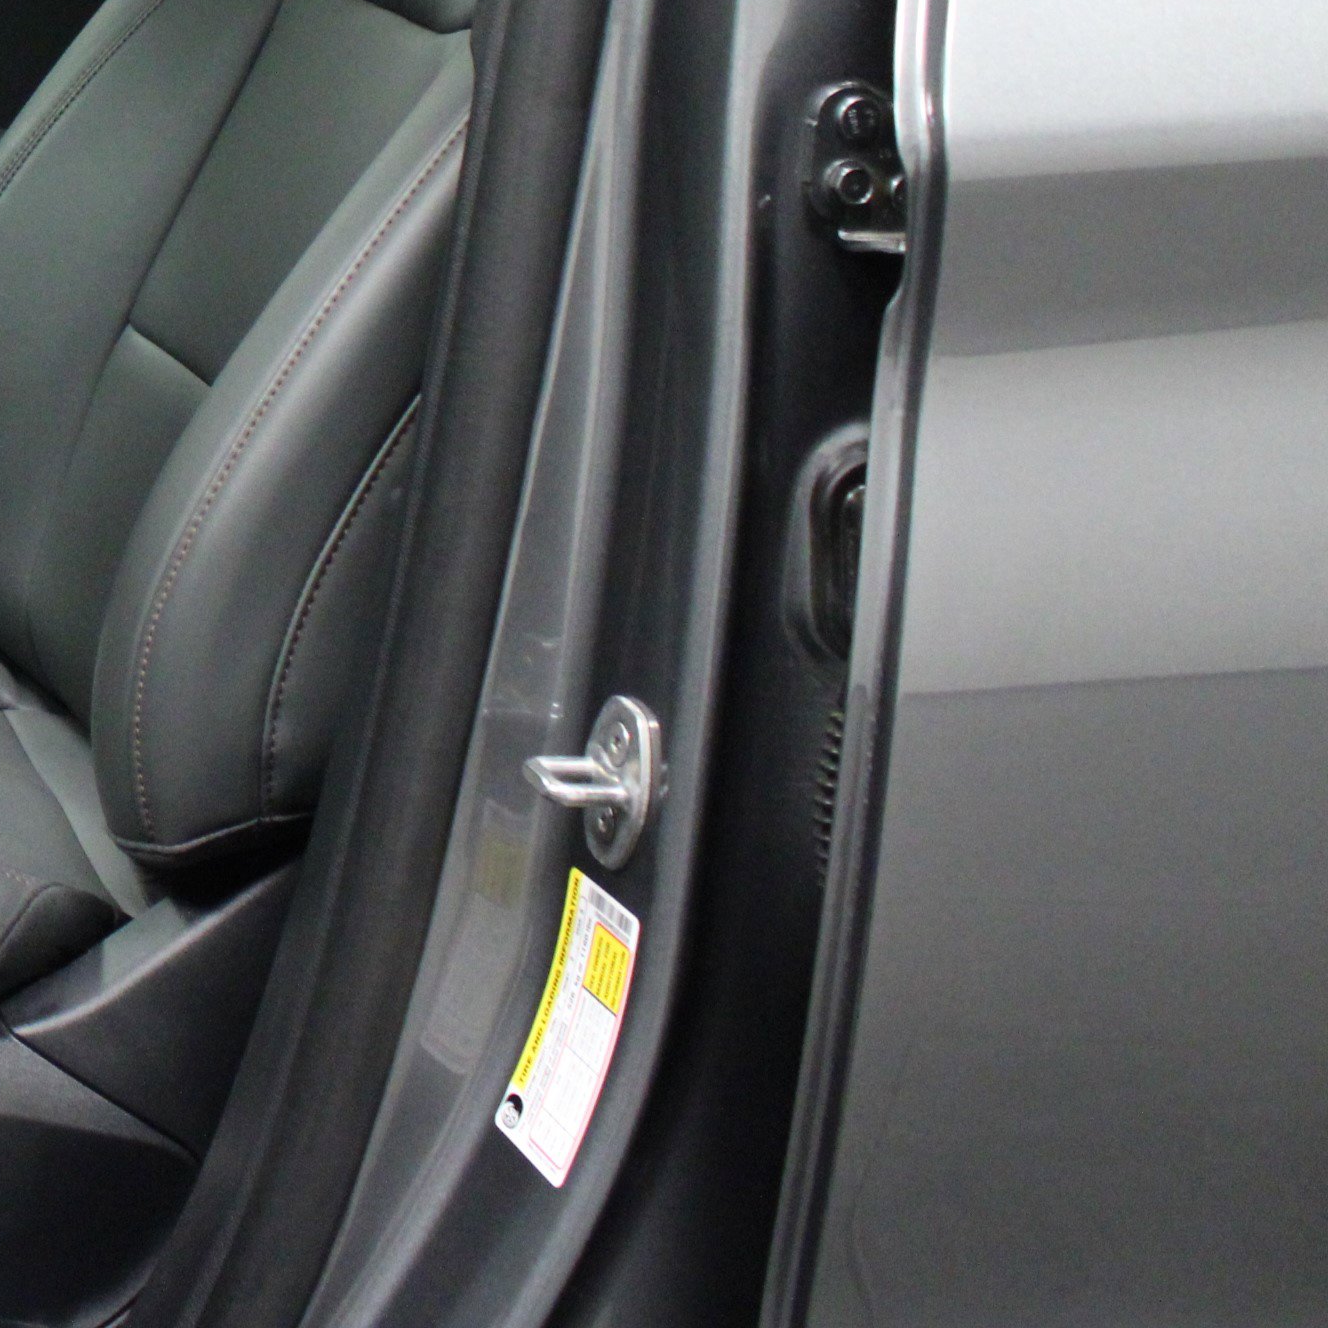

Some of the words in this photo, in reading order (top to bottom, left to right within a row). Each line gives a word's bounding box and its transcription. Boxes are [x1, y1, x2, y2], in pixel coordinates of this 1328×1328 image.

[531, 1026, 543, 1053] AND
[541, 968, 562, 1024] LOADING
[559, 877, 580, 966] INFORMATION
